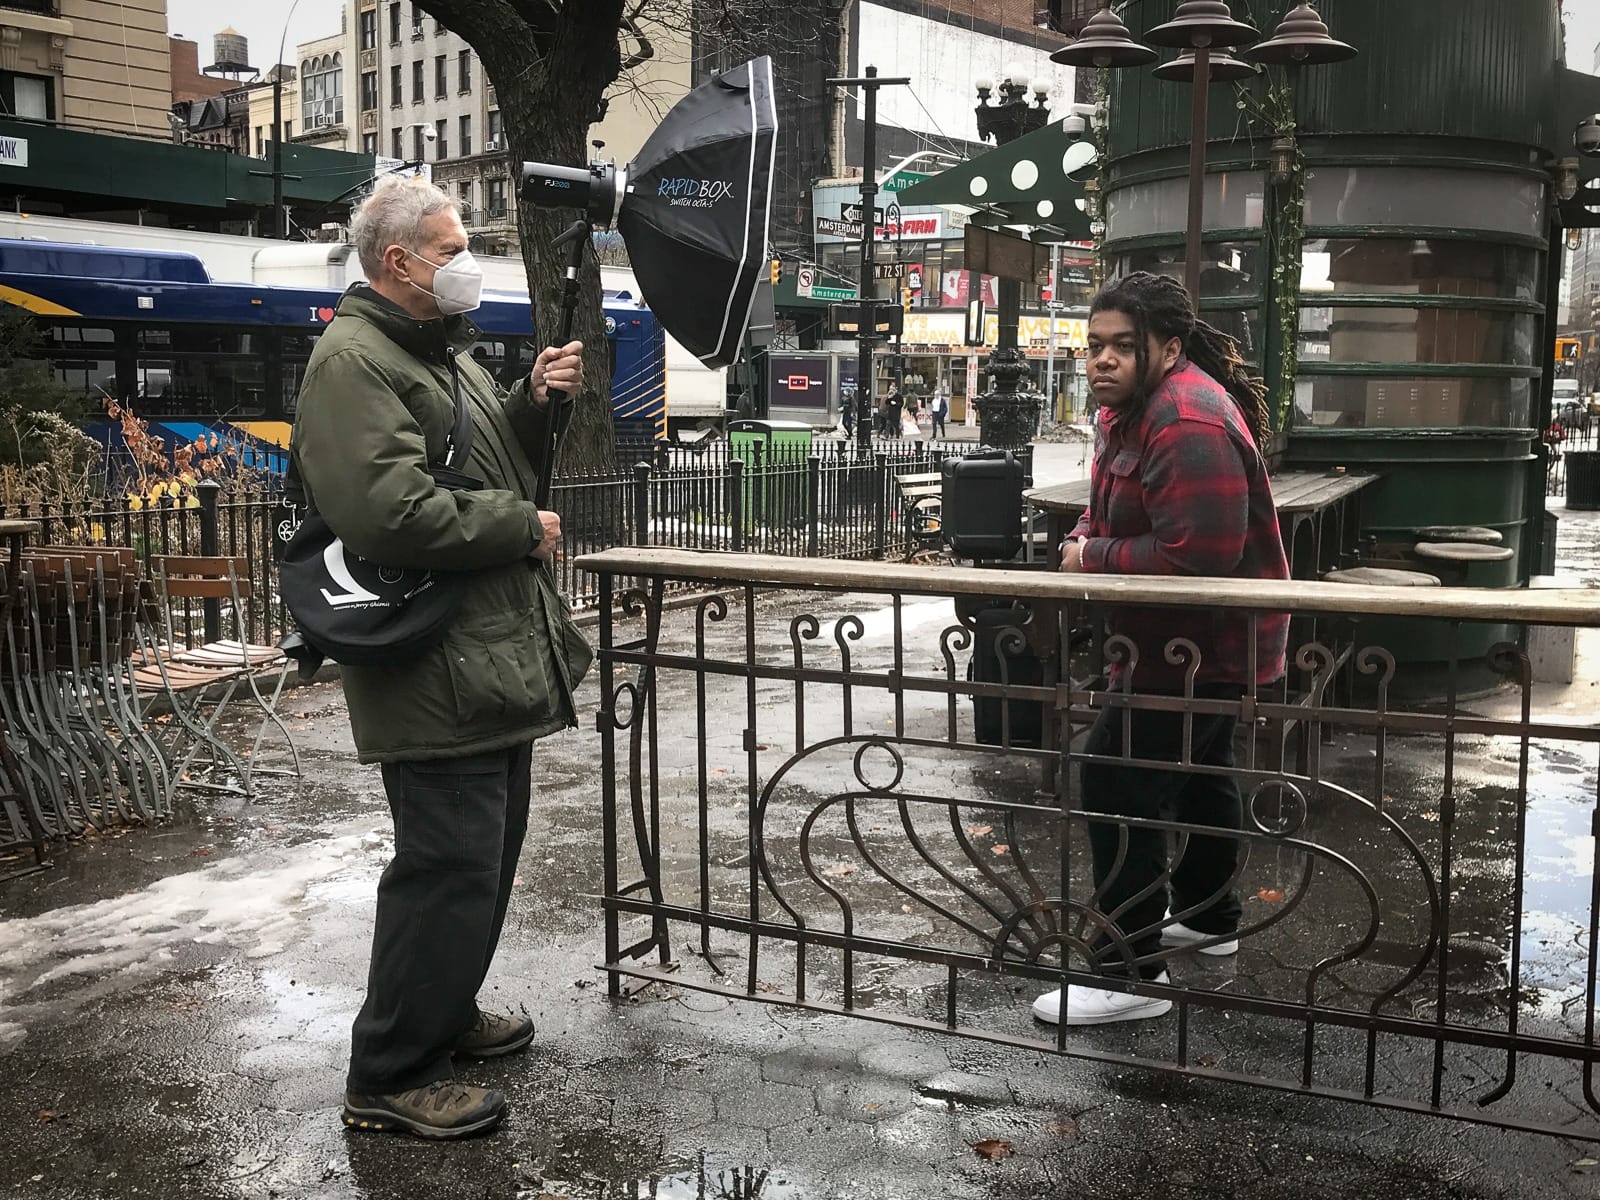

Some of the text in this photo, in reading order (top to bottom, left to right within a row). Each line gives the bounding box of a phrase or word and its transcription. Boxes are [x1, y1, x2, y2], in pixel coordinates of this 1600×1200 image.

[669, 197, 691, 207] SWITCH
[818, 220, 861, 236] AMSTERDAM
[874, 264, 904, 278] W 72 ST
[812, 289, 852, 299] Amsterdam
